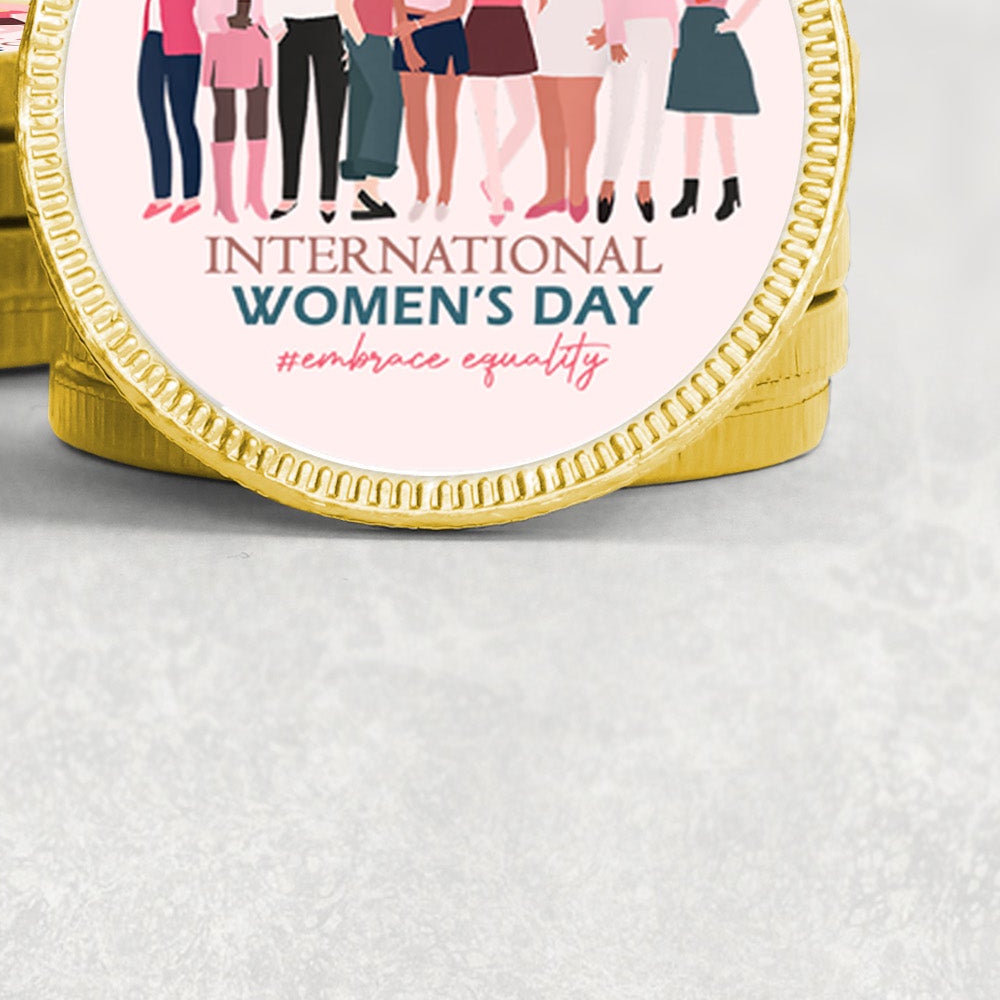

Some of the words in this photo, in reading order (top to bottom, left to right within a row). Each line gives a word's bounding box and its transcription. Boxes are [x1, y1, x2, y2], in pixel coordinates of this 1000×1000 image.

[203, 235, 663, 275] INTERNATIONAL
[231, 285, 514, 326] WOMEN'S
[534, 285, 654, 326] DAY
[276, 332, 450, 374] #embrace
[461, 332, 611, 391] equality
